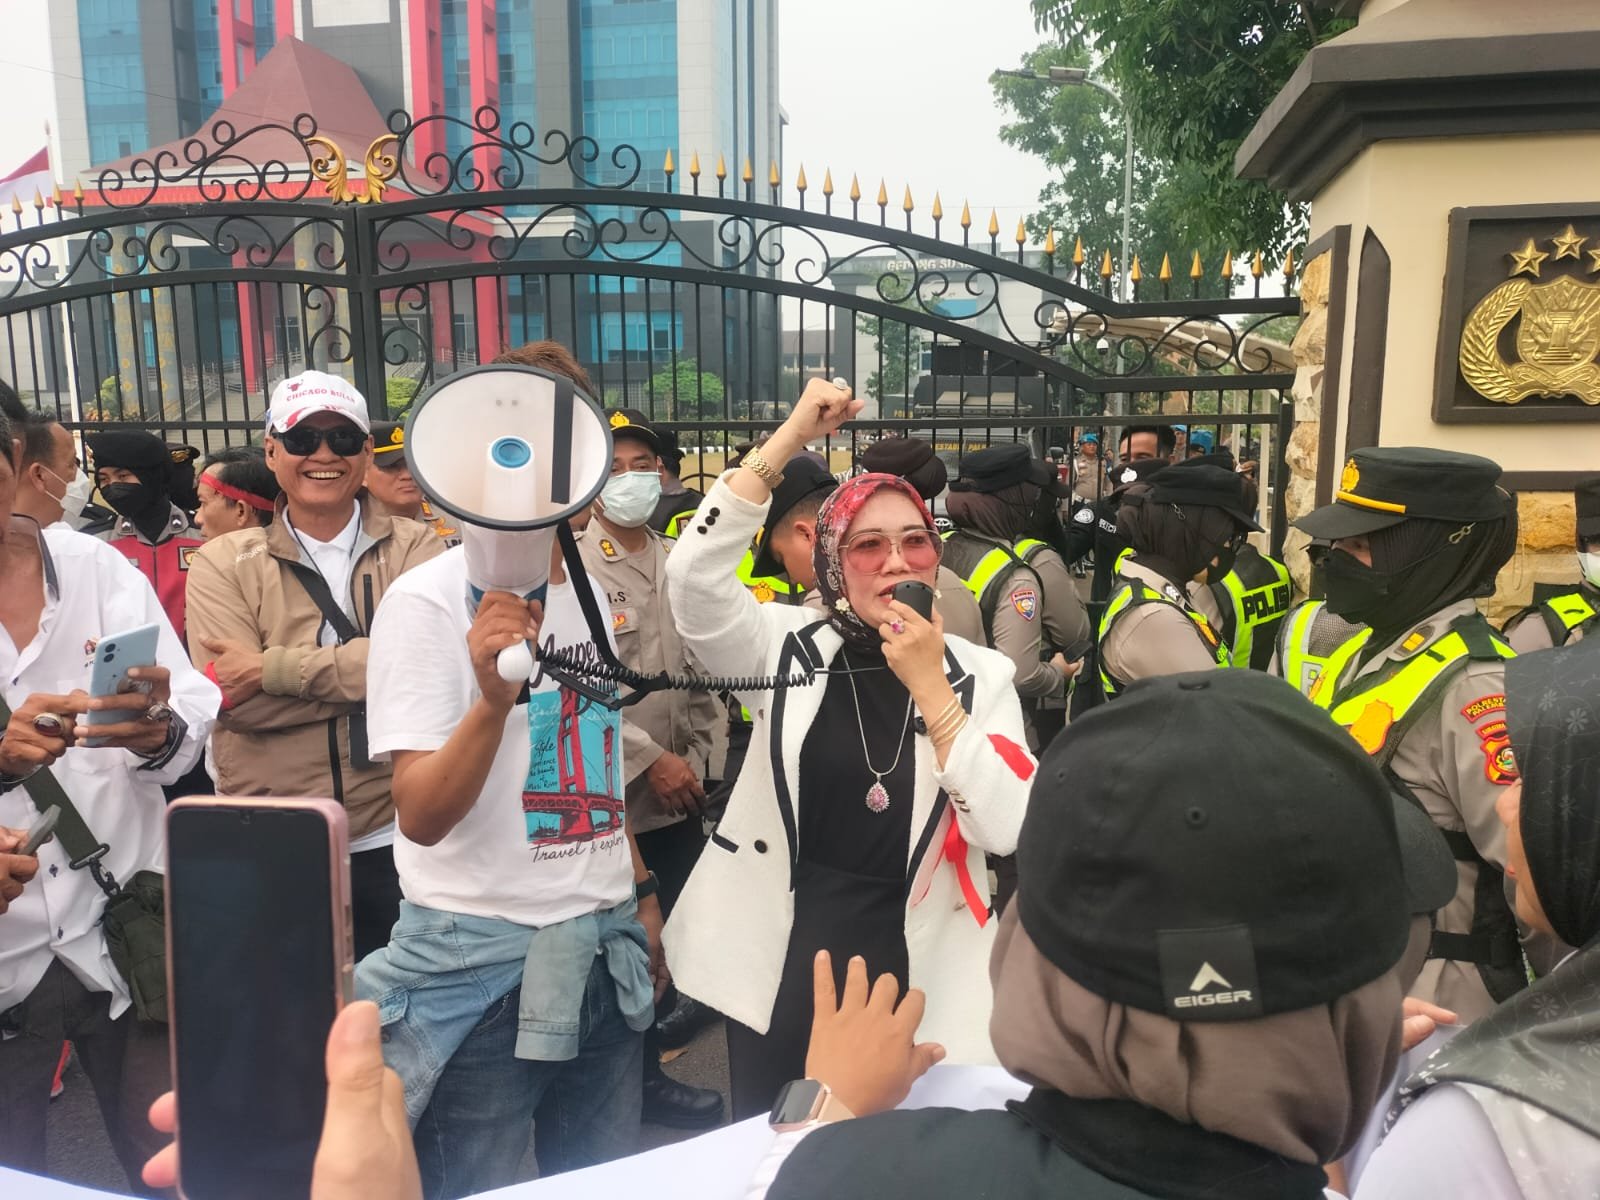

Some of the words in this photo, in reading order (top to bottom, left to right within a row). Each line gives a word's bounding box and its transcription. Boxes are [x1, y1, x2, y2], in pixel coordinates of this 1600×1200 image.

[887, 260, 937, 271] GEDNG
[286, 388, 328, 402] CHICAGO
[330, 390, 355, 404] BULLS
[1466, 696, 1506, 714] POLREST
[530, 838, 587, 863] Travel
[1174, 990, 1253, 1008] EIGER
